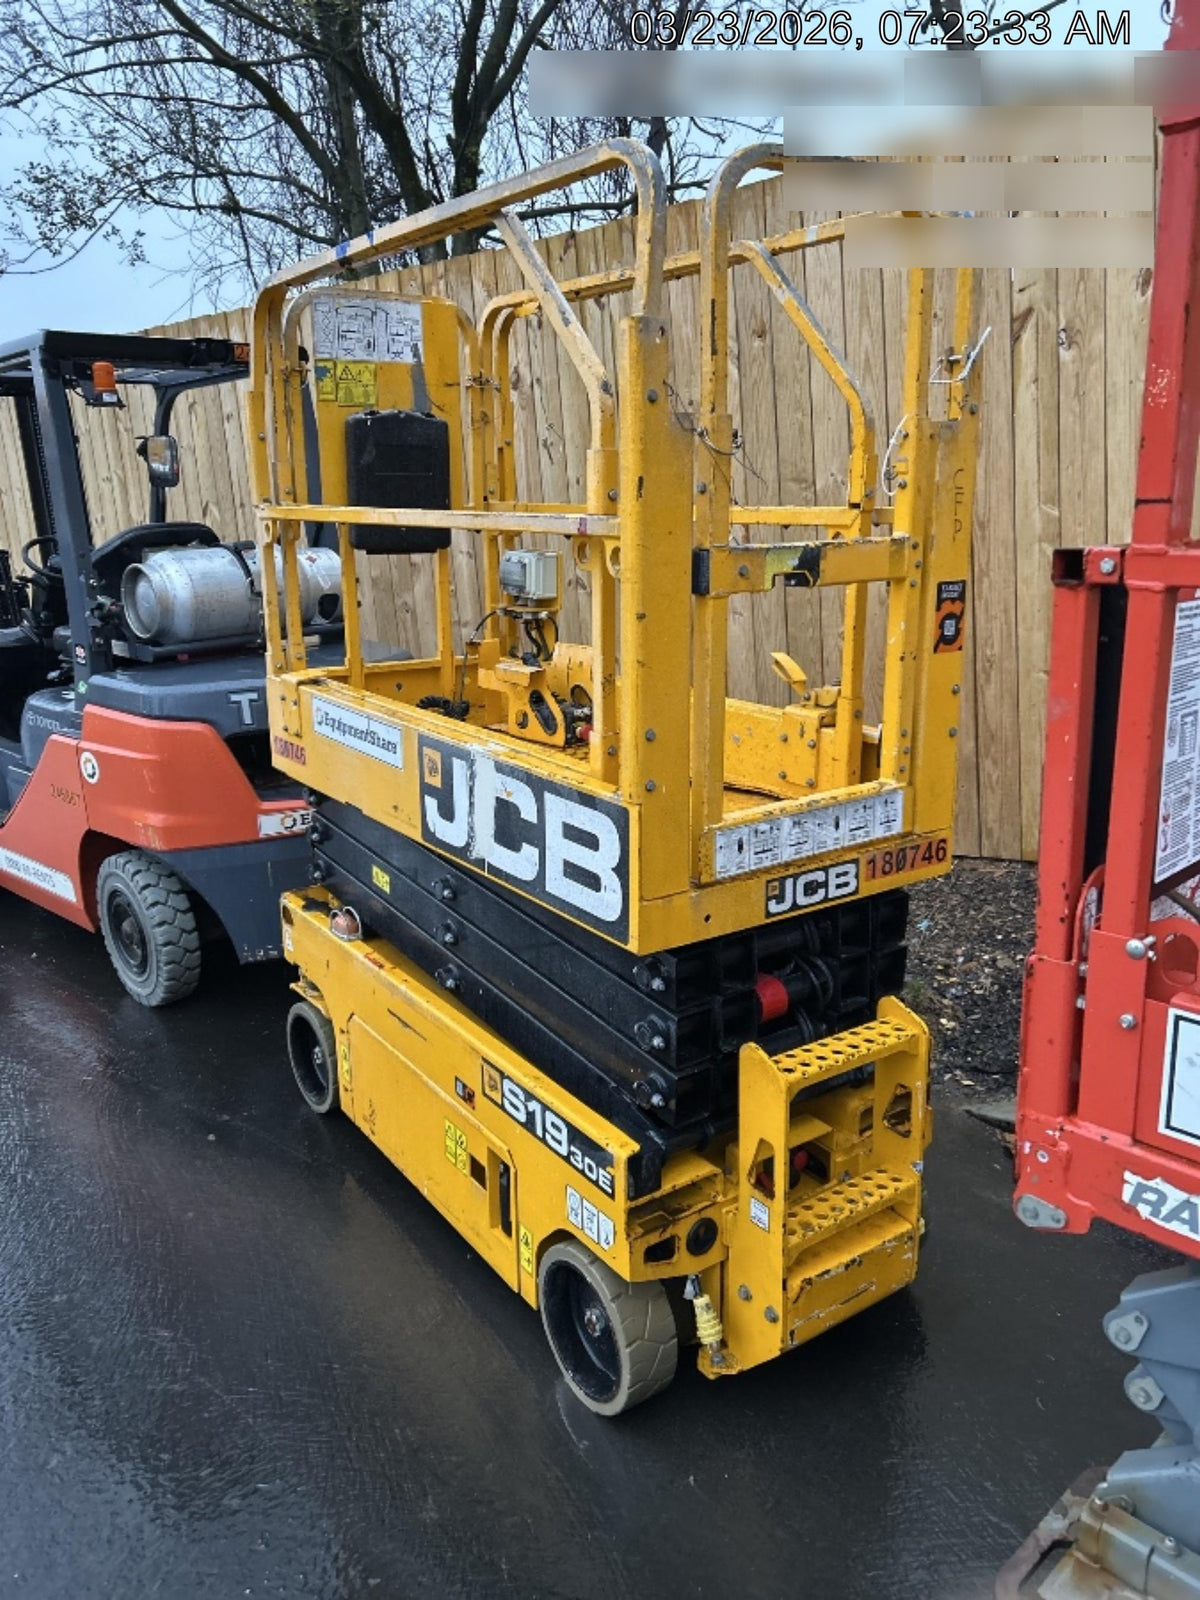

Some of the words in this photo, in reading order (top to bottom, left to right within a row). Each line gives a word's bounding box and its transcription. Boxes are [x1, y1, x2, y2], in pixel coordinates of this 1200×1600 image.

[424, 756, 623, 922] JCB
[867, 838, 948, 879] 180746
[767, 863, 858, 915] JCB
[502, 1077, 568, 1156] S19
[570, 1146, 613, 1195] 30E
